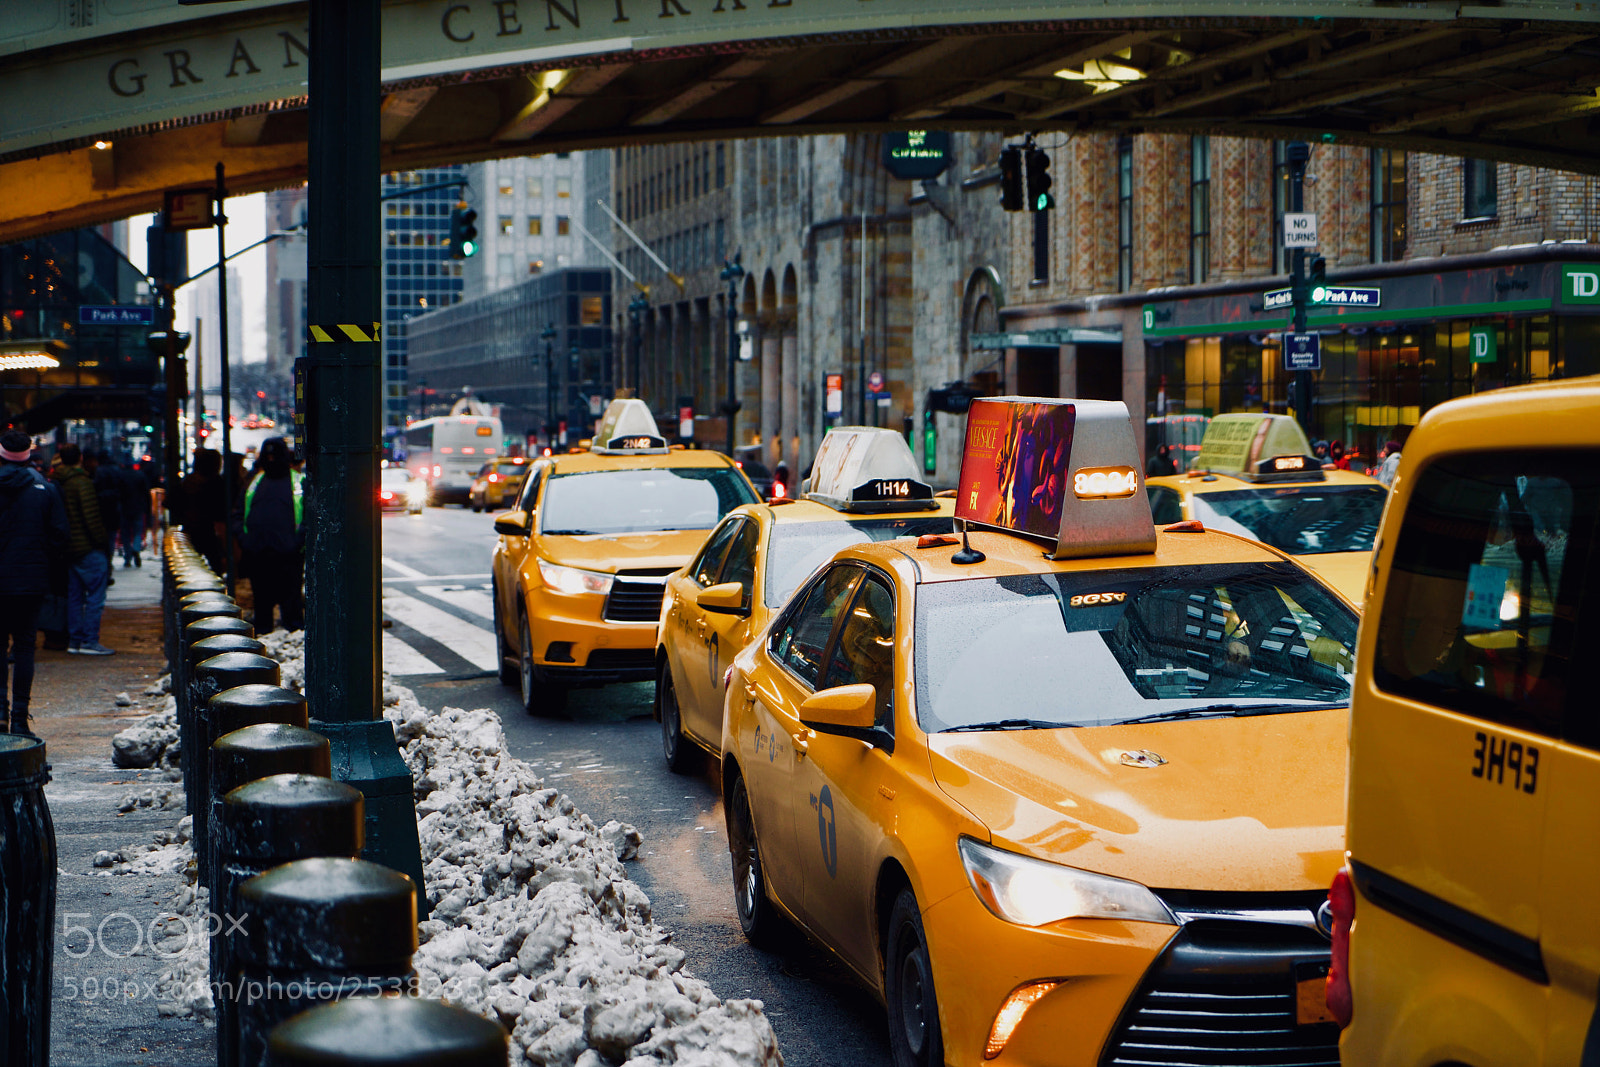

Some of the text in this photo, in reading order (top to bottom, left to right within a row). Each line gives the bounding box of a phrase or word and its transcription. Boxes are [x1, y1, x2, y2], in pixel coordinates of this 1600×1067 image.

[107, 0, 793, 97] GRAN CENT
[1293, 219, 1308, 229] NO
[1286, 232, 1316, 242] TURNS
[1566, 272, 1599, 297] TD
[1325, 289, 1369, 303] Park Ave
[93, 309, 142, 320] Park Ave
[1473, 332, 1488, 357] TD
[623, 438, 651, 449] 2N42
[875, 481, 909, 496] 1H14
[1472, 731, 1539, 795] 3H93
